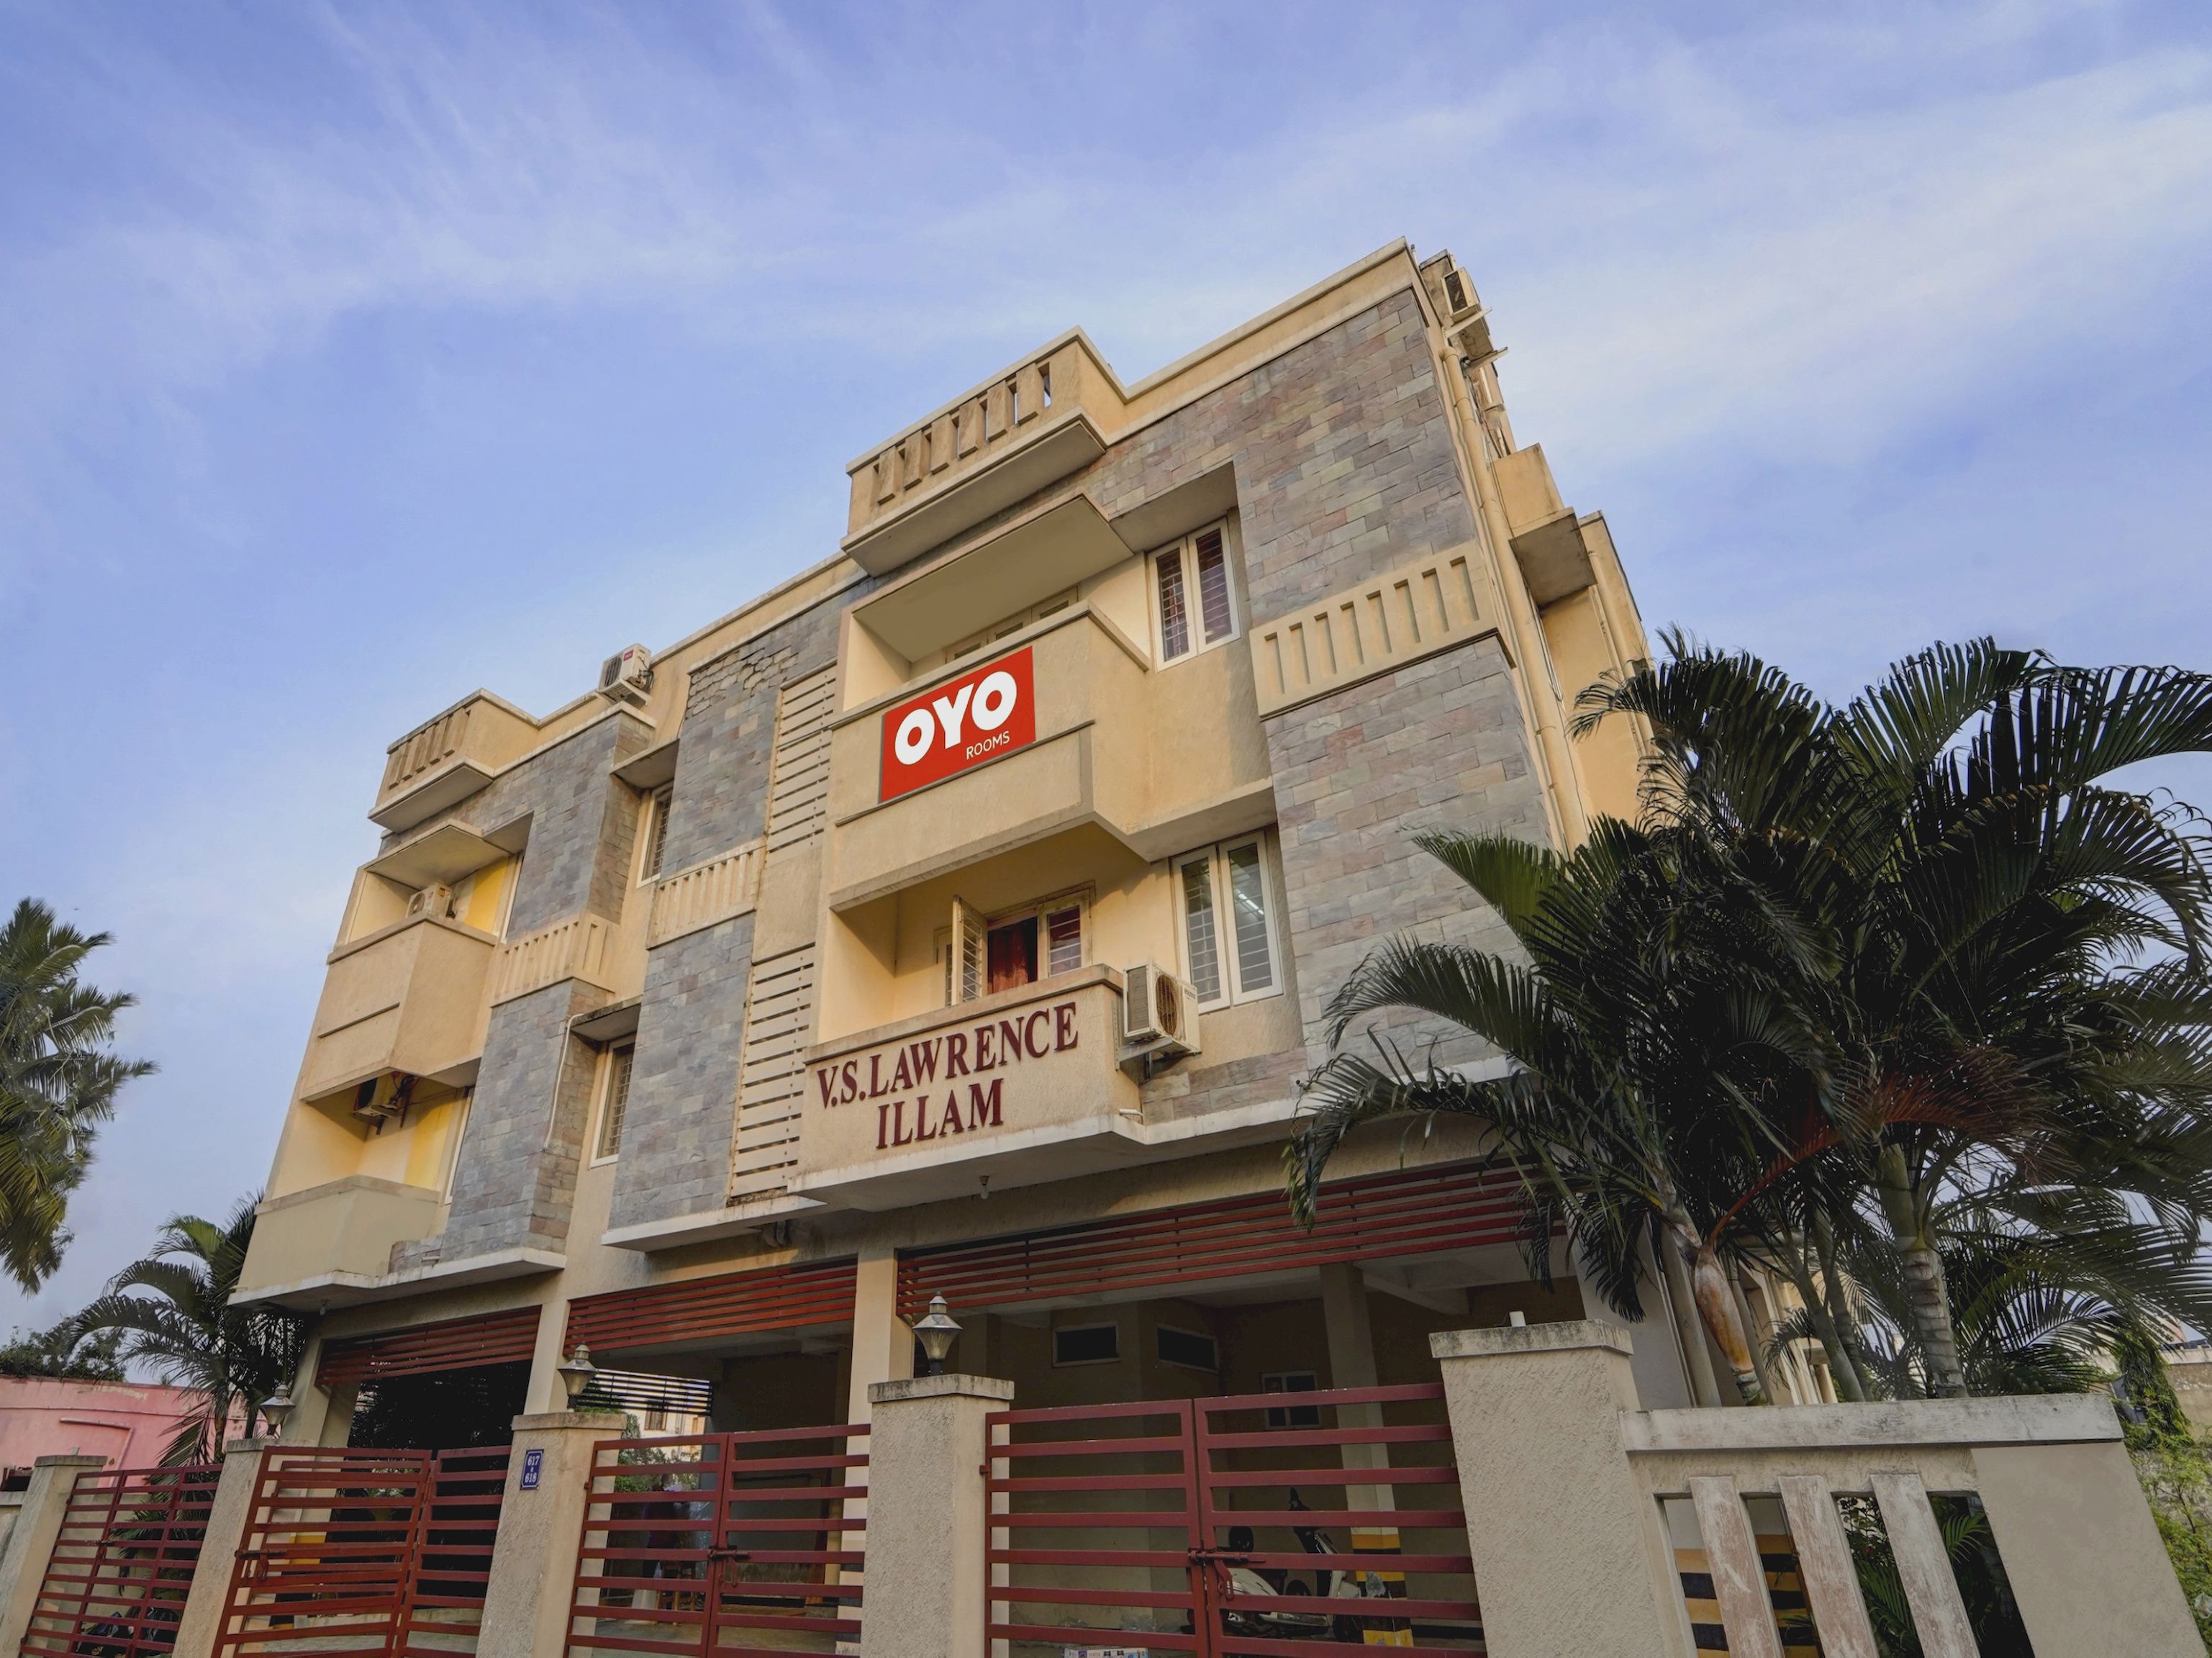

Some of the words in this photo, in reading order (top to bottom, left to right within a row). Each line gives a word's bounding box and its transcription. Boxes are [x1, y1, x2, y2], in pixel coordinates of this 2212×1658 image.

[894, 671, 1017, 765] OYO
[966, 731, 1010, 760] ROOMS
[876, 1078, 1004, 1149] ILLAM
[527, 1455, 540, 1466] 617
